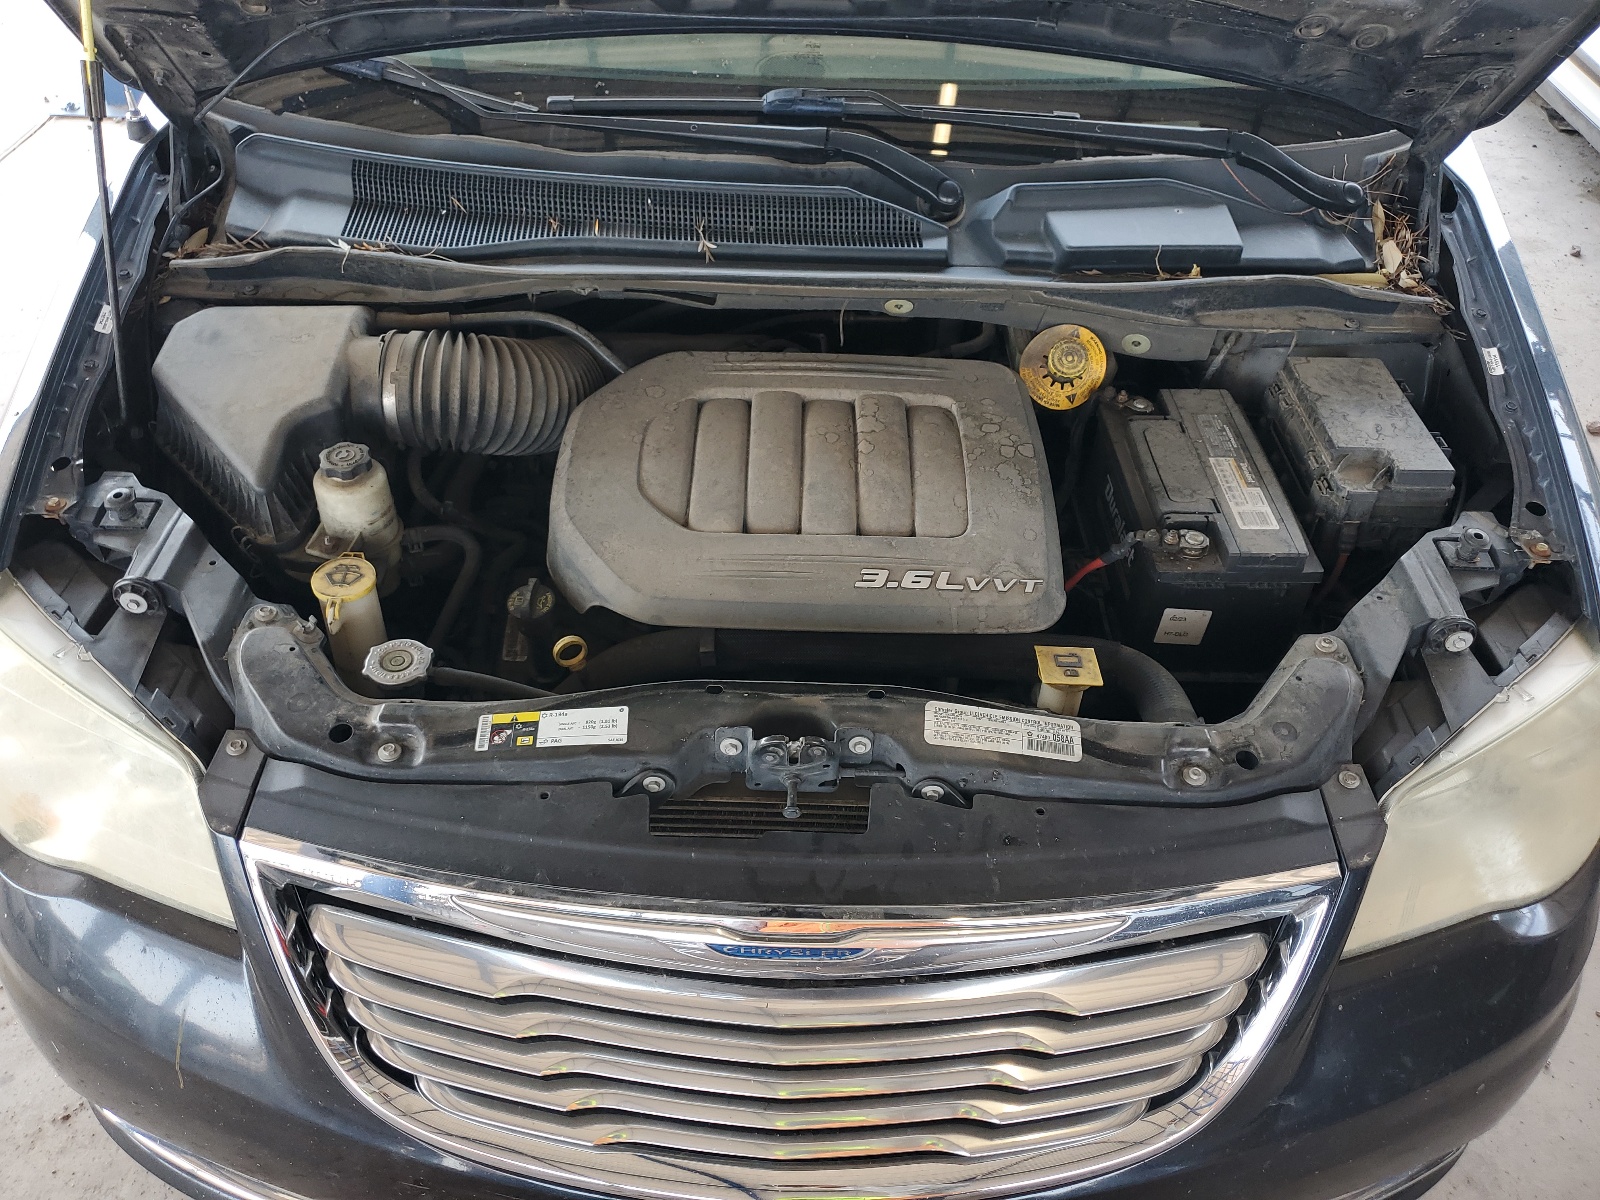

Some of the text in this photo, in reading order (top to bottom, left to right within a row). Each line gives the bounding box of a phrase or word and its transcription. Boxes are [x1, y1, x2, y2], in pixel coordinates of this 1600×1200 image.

[854, 567, 1044, 594] 3.6L VVT
[1052, 735, 1074, 744] 058AA
[723, 946, 852, 957] CHRYSLER
